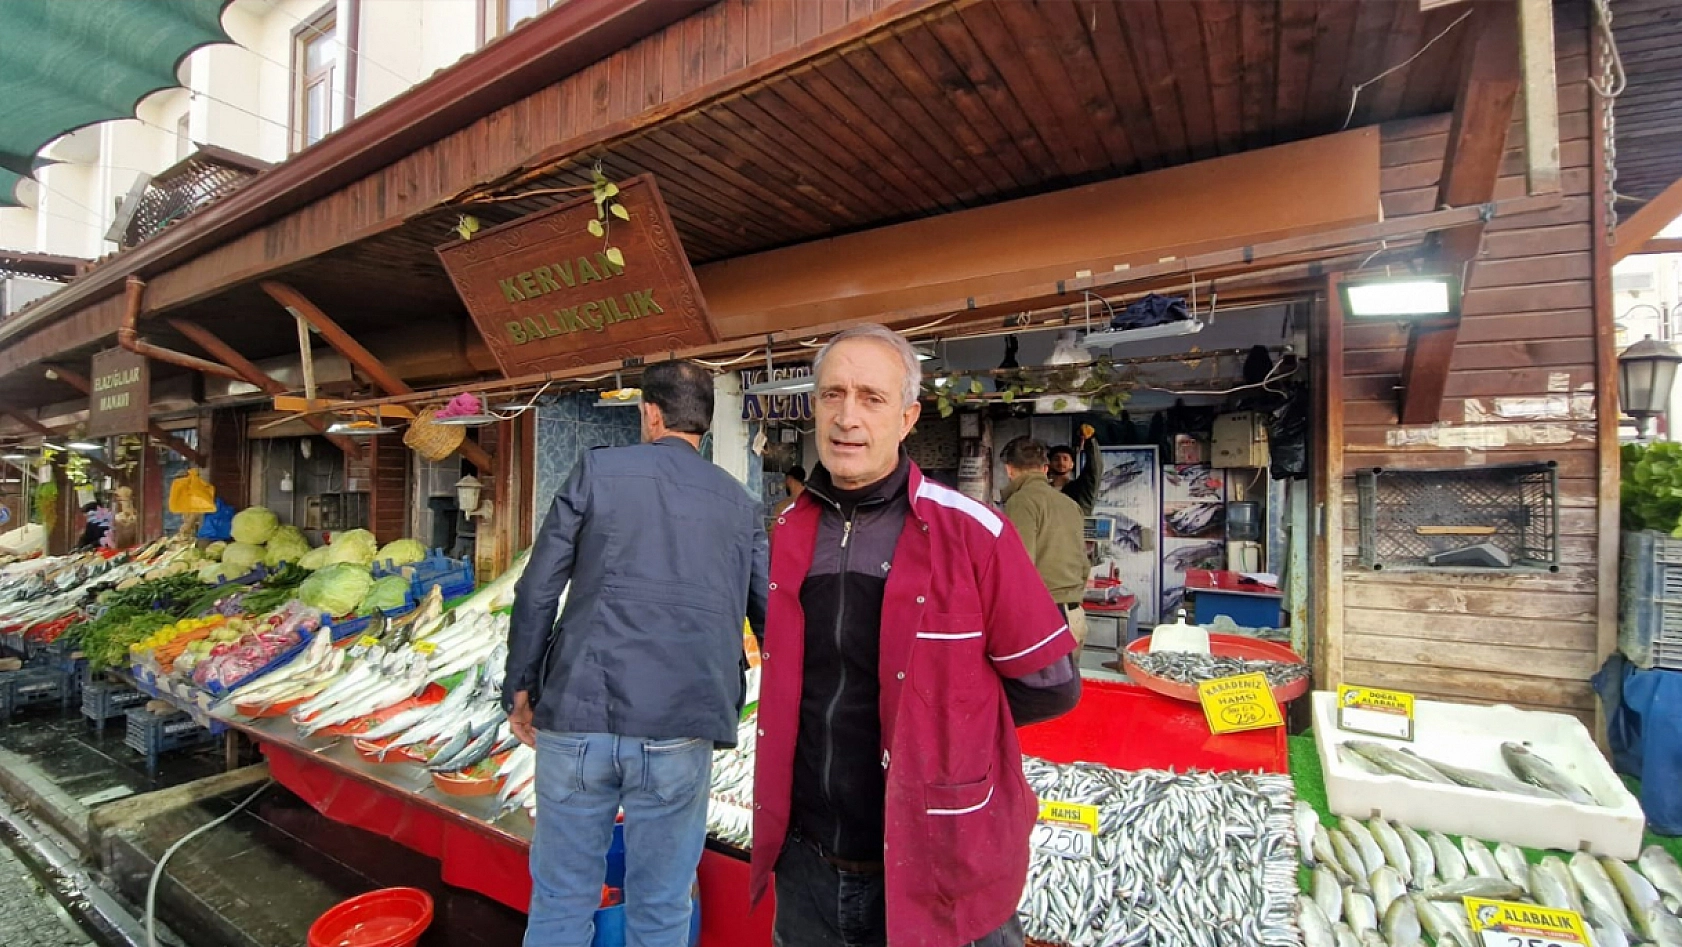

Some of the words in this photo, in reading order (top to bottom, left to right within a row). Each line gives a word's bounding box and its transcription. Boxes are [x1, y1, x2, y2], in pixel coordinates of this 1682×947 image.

[500, 252, 626, 303] KERVAN
[505, 288, 664, 345] BALIKÇILIK
[1039, 826, 1084, 854] 250
[1504, 909, 1574, 930] ALABALIK
